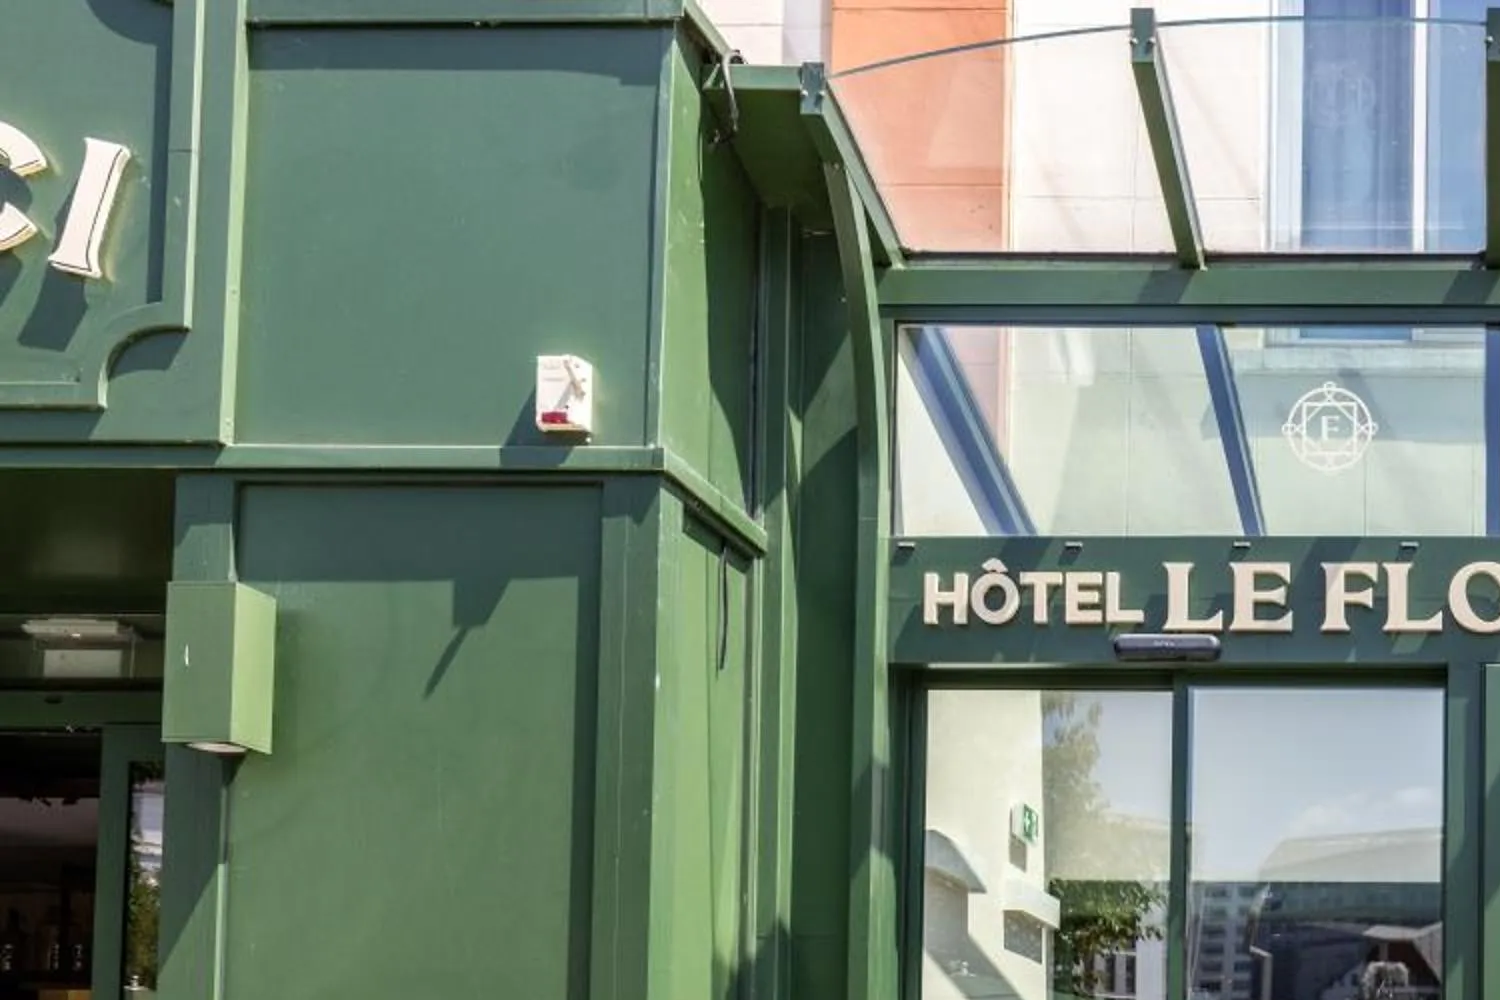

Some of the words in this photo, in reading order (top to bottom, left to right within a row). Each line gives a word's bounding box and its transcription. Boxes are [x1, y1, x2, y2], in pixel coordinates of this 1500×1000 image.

[1321, 415, 1339, 442] F
[923, 557, 1145, 625] HÔTEL
[1161, 561, 1294, 632] LE
